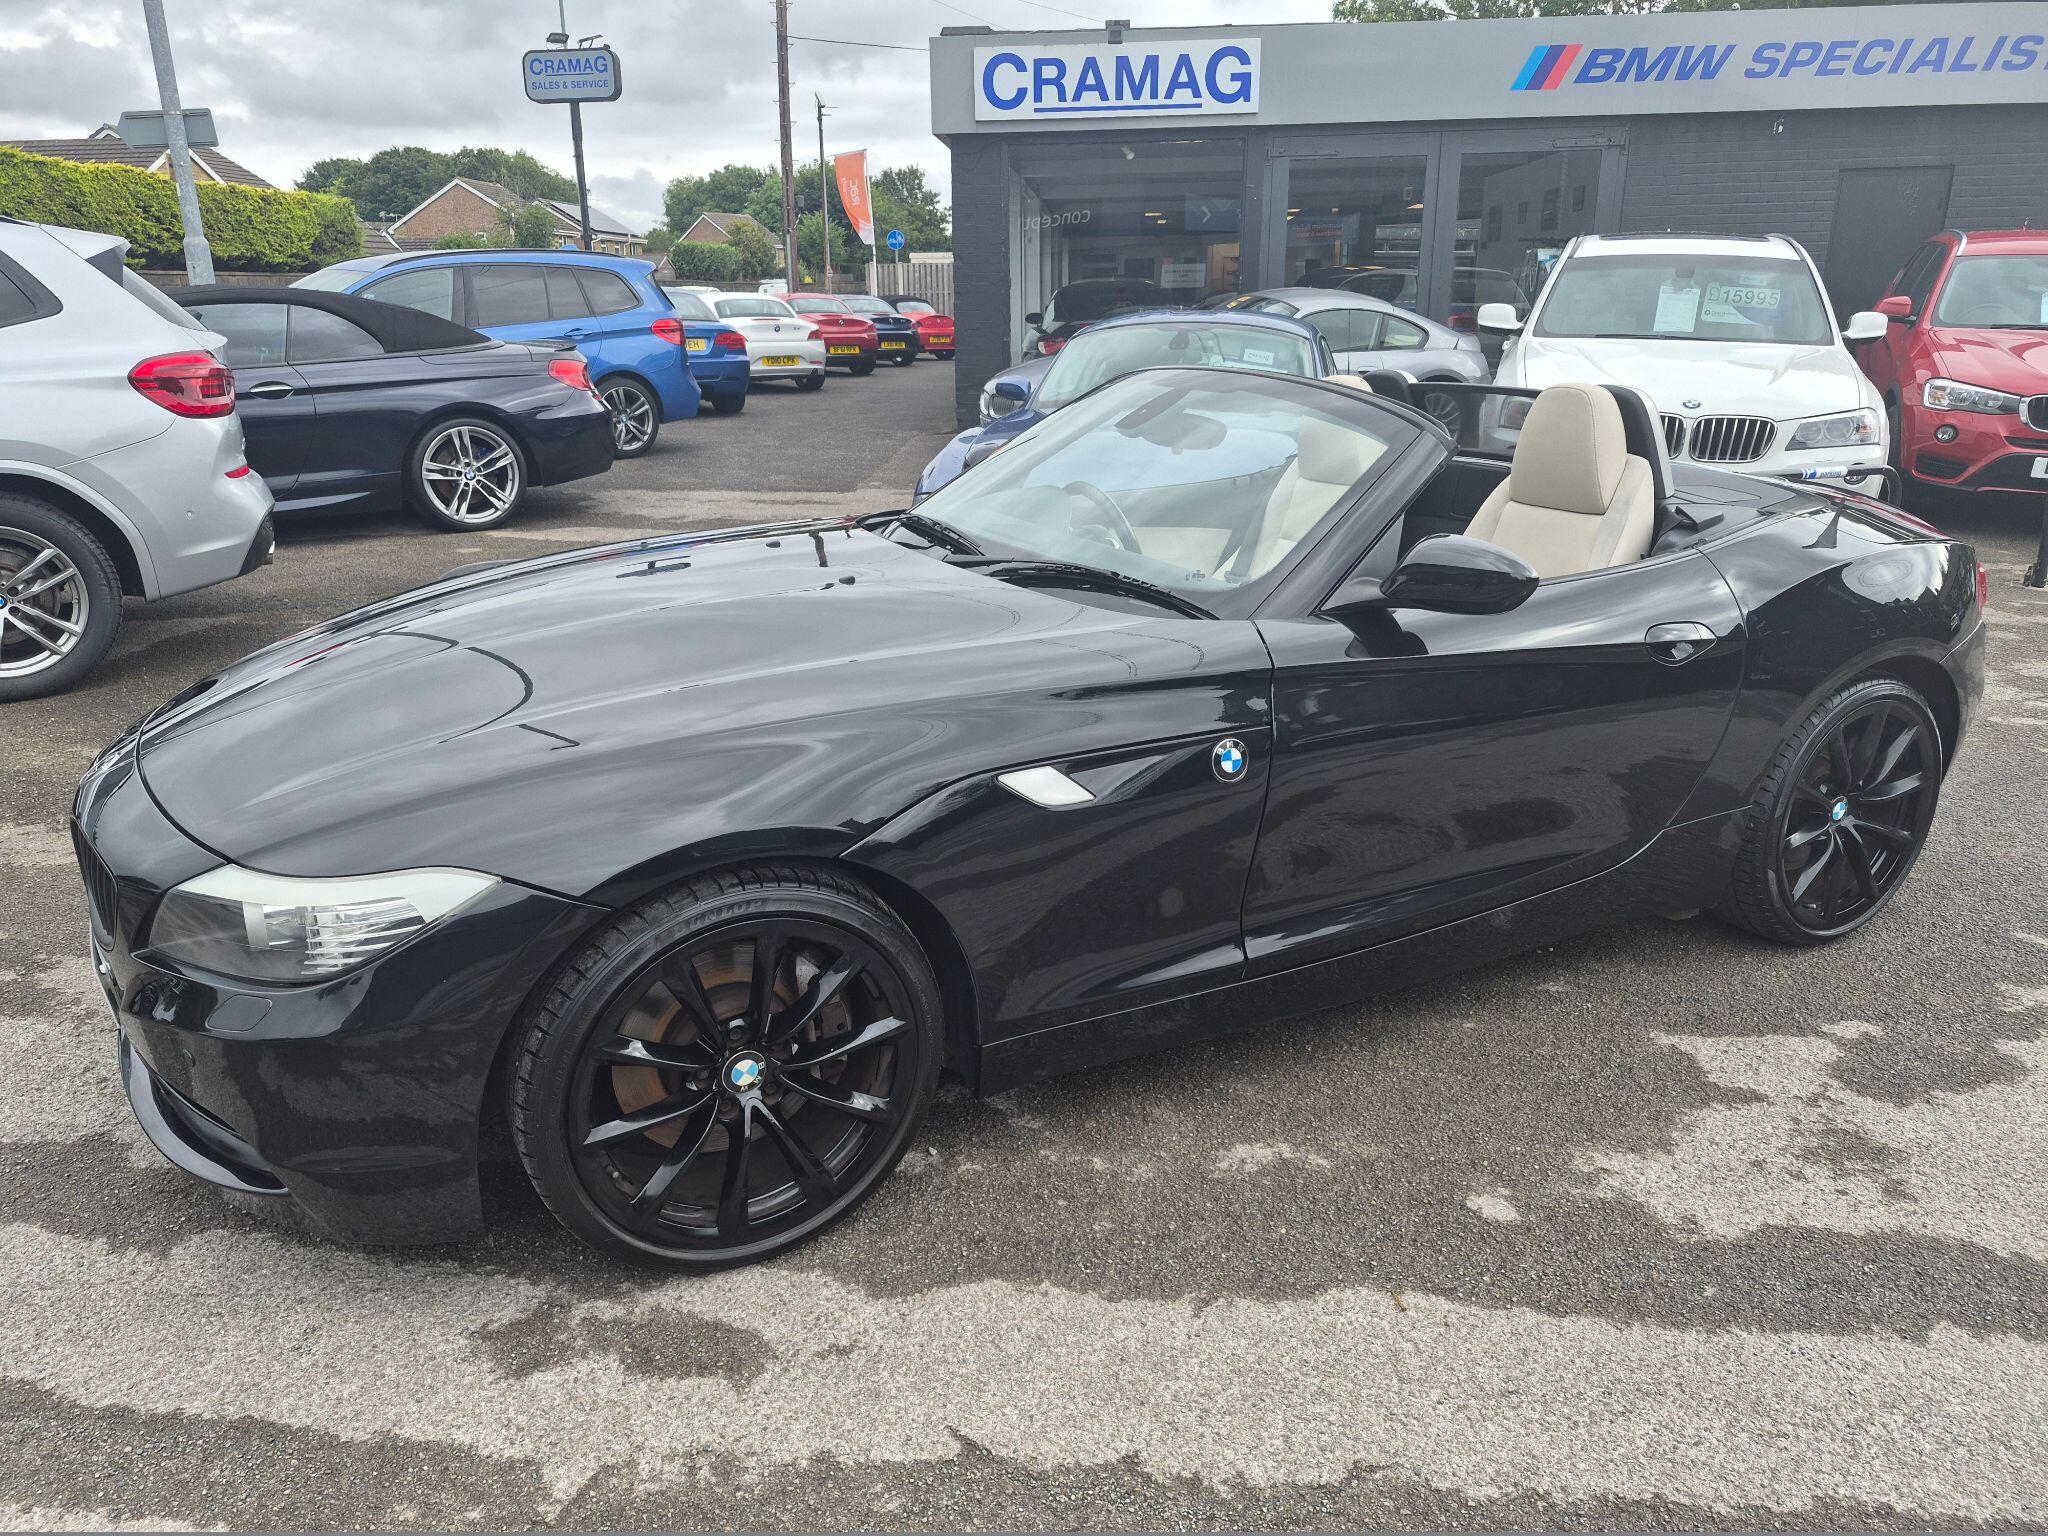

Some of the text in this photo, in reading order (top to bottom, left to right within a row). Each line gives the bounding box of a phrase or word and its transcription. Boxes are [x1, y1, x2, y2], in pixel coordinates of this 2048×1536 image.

[529, 55, 609, 75] CRAMAG
[1573, 34, 2048, 83] BMW SPECIALIS
[531, 80, 609, 90] SALES & SERVICE
[983, 46, 1252, 110] CRAMAG
[1708, 286, 1779, 306] £15995
